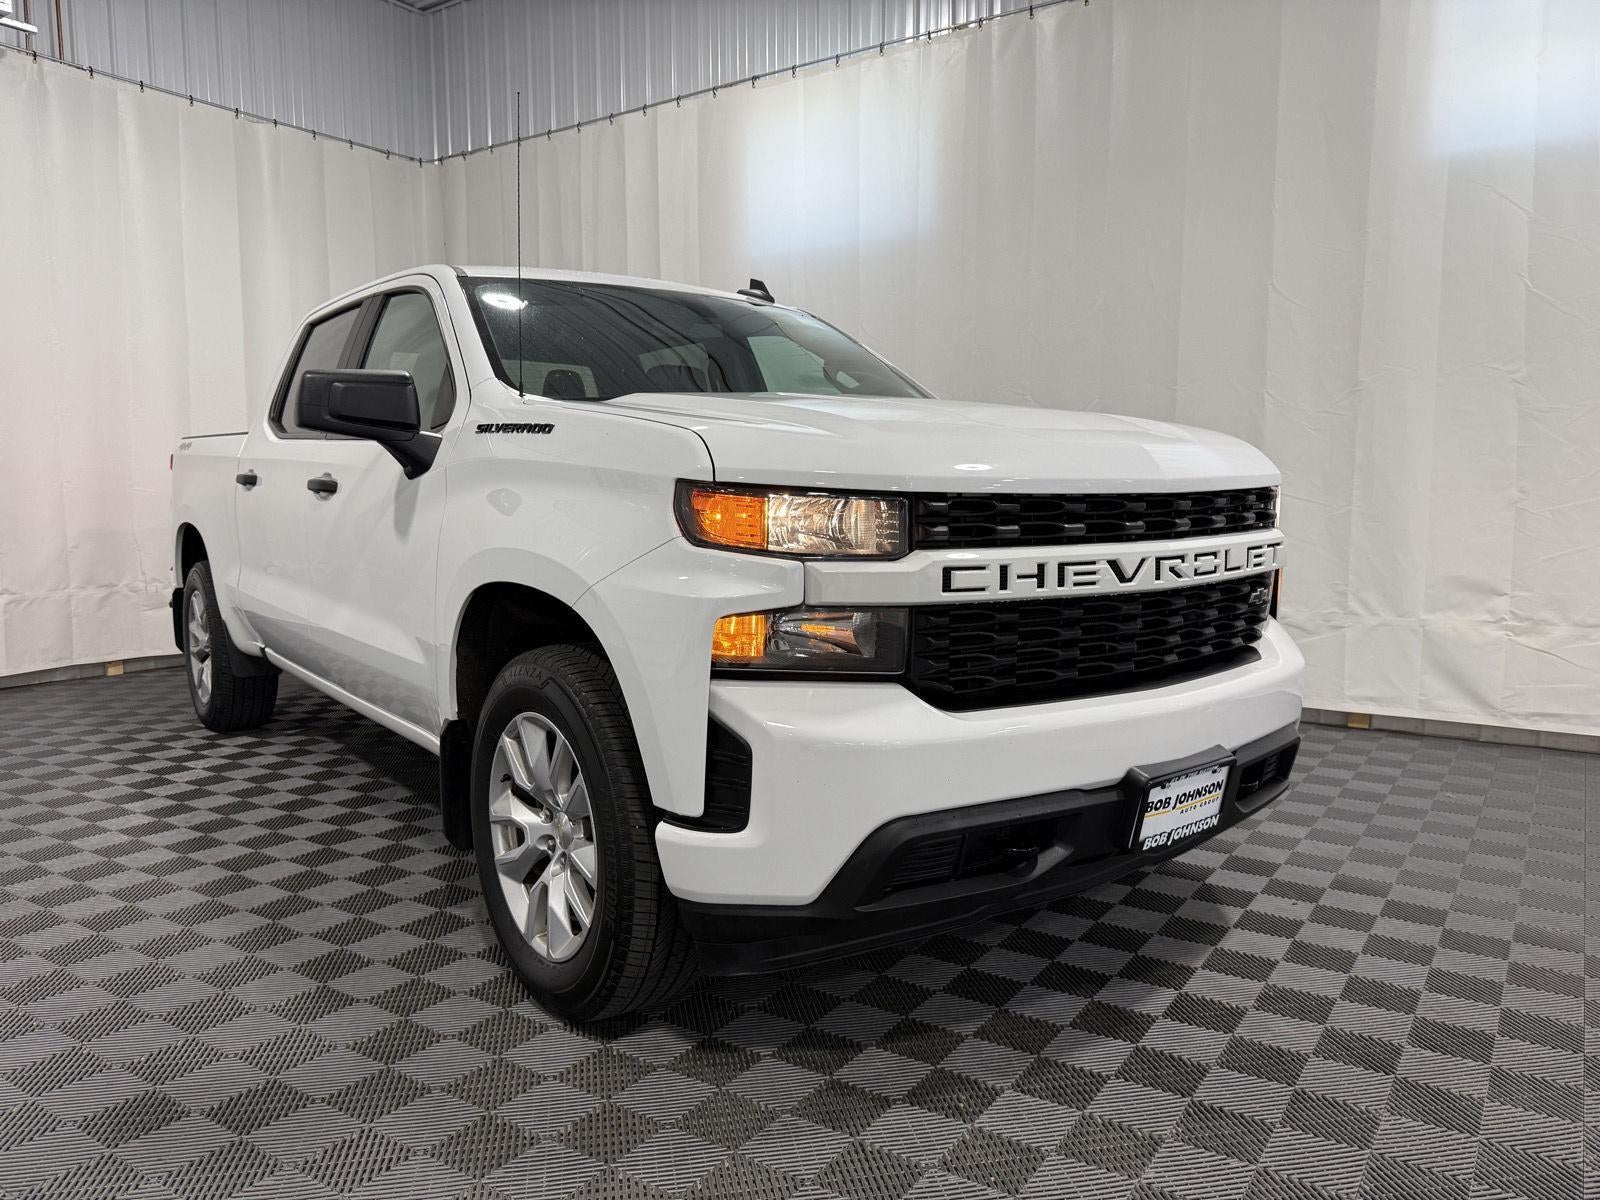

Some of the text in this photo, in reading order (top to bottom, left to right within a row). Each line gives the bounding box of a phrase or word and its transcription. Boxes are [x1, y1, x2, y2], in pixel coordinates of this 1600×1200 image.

[475, 423, 555, 434] SILVERADO
[941, 542, 1285, 594] CHEVROLET
[1145, 779, 1224, 813] BOB JOHNSON
[1180, 796, 1219, 815] AUTO GROUP
[1142, 815, 1219, 851] BOB JOHNSON
